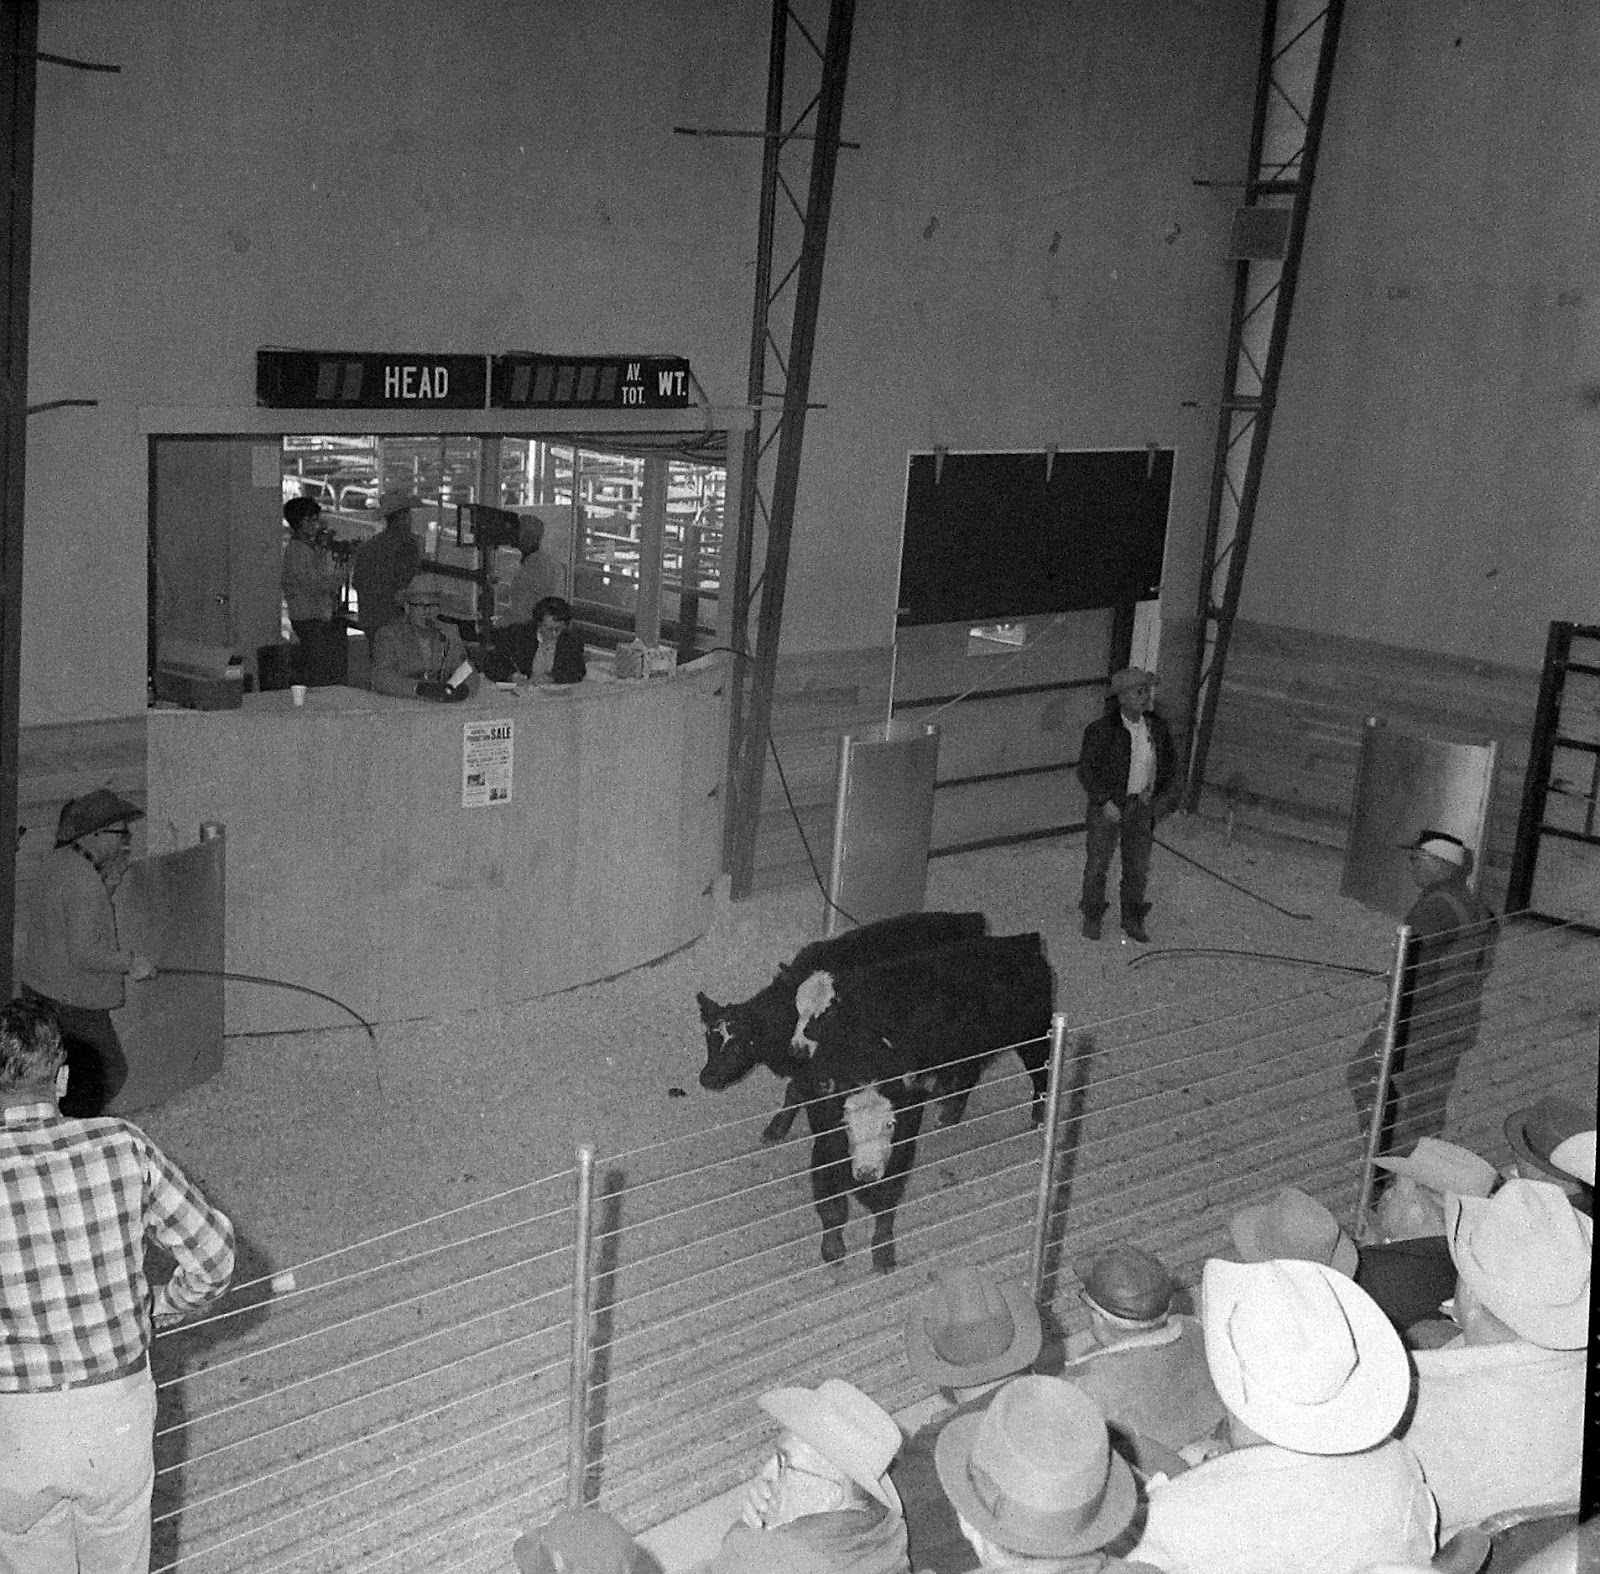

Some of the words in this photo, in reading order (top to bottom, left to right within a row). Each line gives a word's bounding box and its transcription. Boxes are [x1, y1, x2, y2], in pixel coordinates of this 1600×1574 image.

[626, 363, 642, 381] AV.
[384, 366, 449, 398] HEAD
[658, 370, 686, 396] WT.
[621, 386, 646, 404] TOT.
[490, 726, 511, 740] SALE
